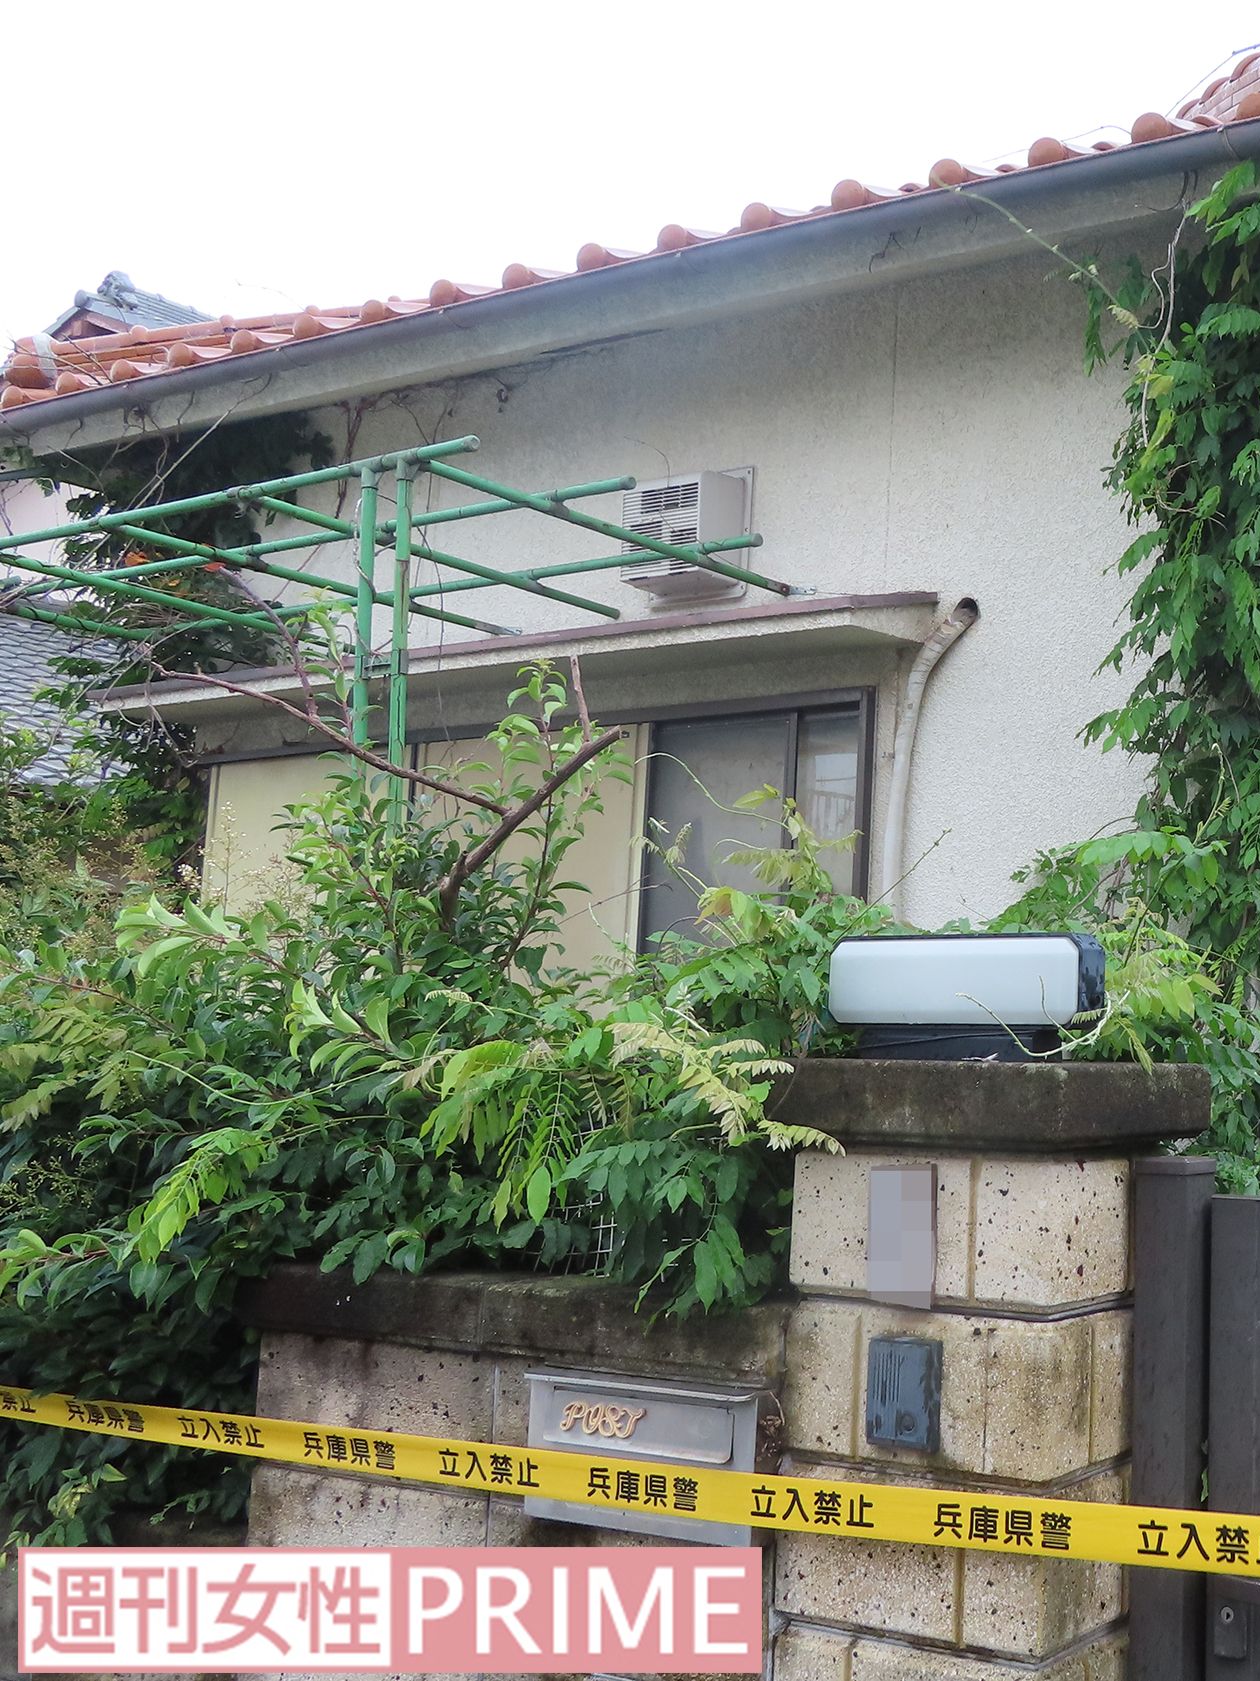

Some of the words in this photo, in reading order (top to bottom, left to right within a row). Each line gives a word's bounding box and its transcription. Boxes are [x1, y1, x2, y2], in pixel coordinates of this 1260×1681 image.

[560, 1401, 645, 1438] POST
[65, 1400, 145, 1432] 兵庫県警
[180, 1416, 265, 1448] 立入禁止
[303, 1432, 397, 1469] 兵庫県警
[438, 1449, 540, 1488] 立入禁止
[587, 1467, 699, 1512] 兵庫県警
[750, 1485, 875, 1529] 立入禁止
[933, 1503, 1073, 1550] 兵庫県警
